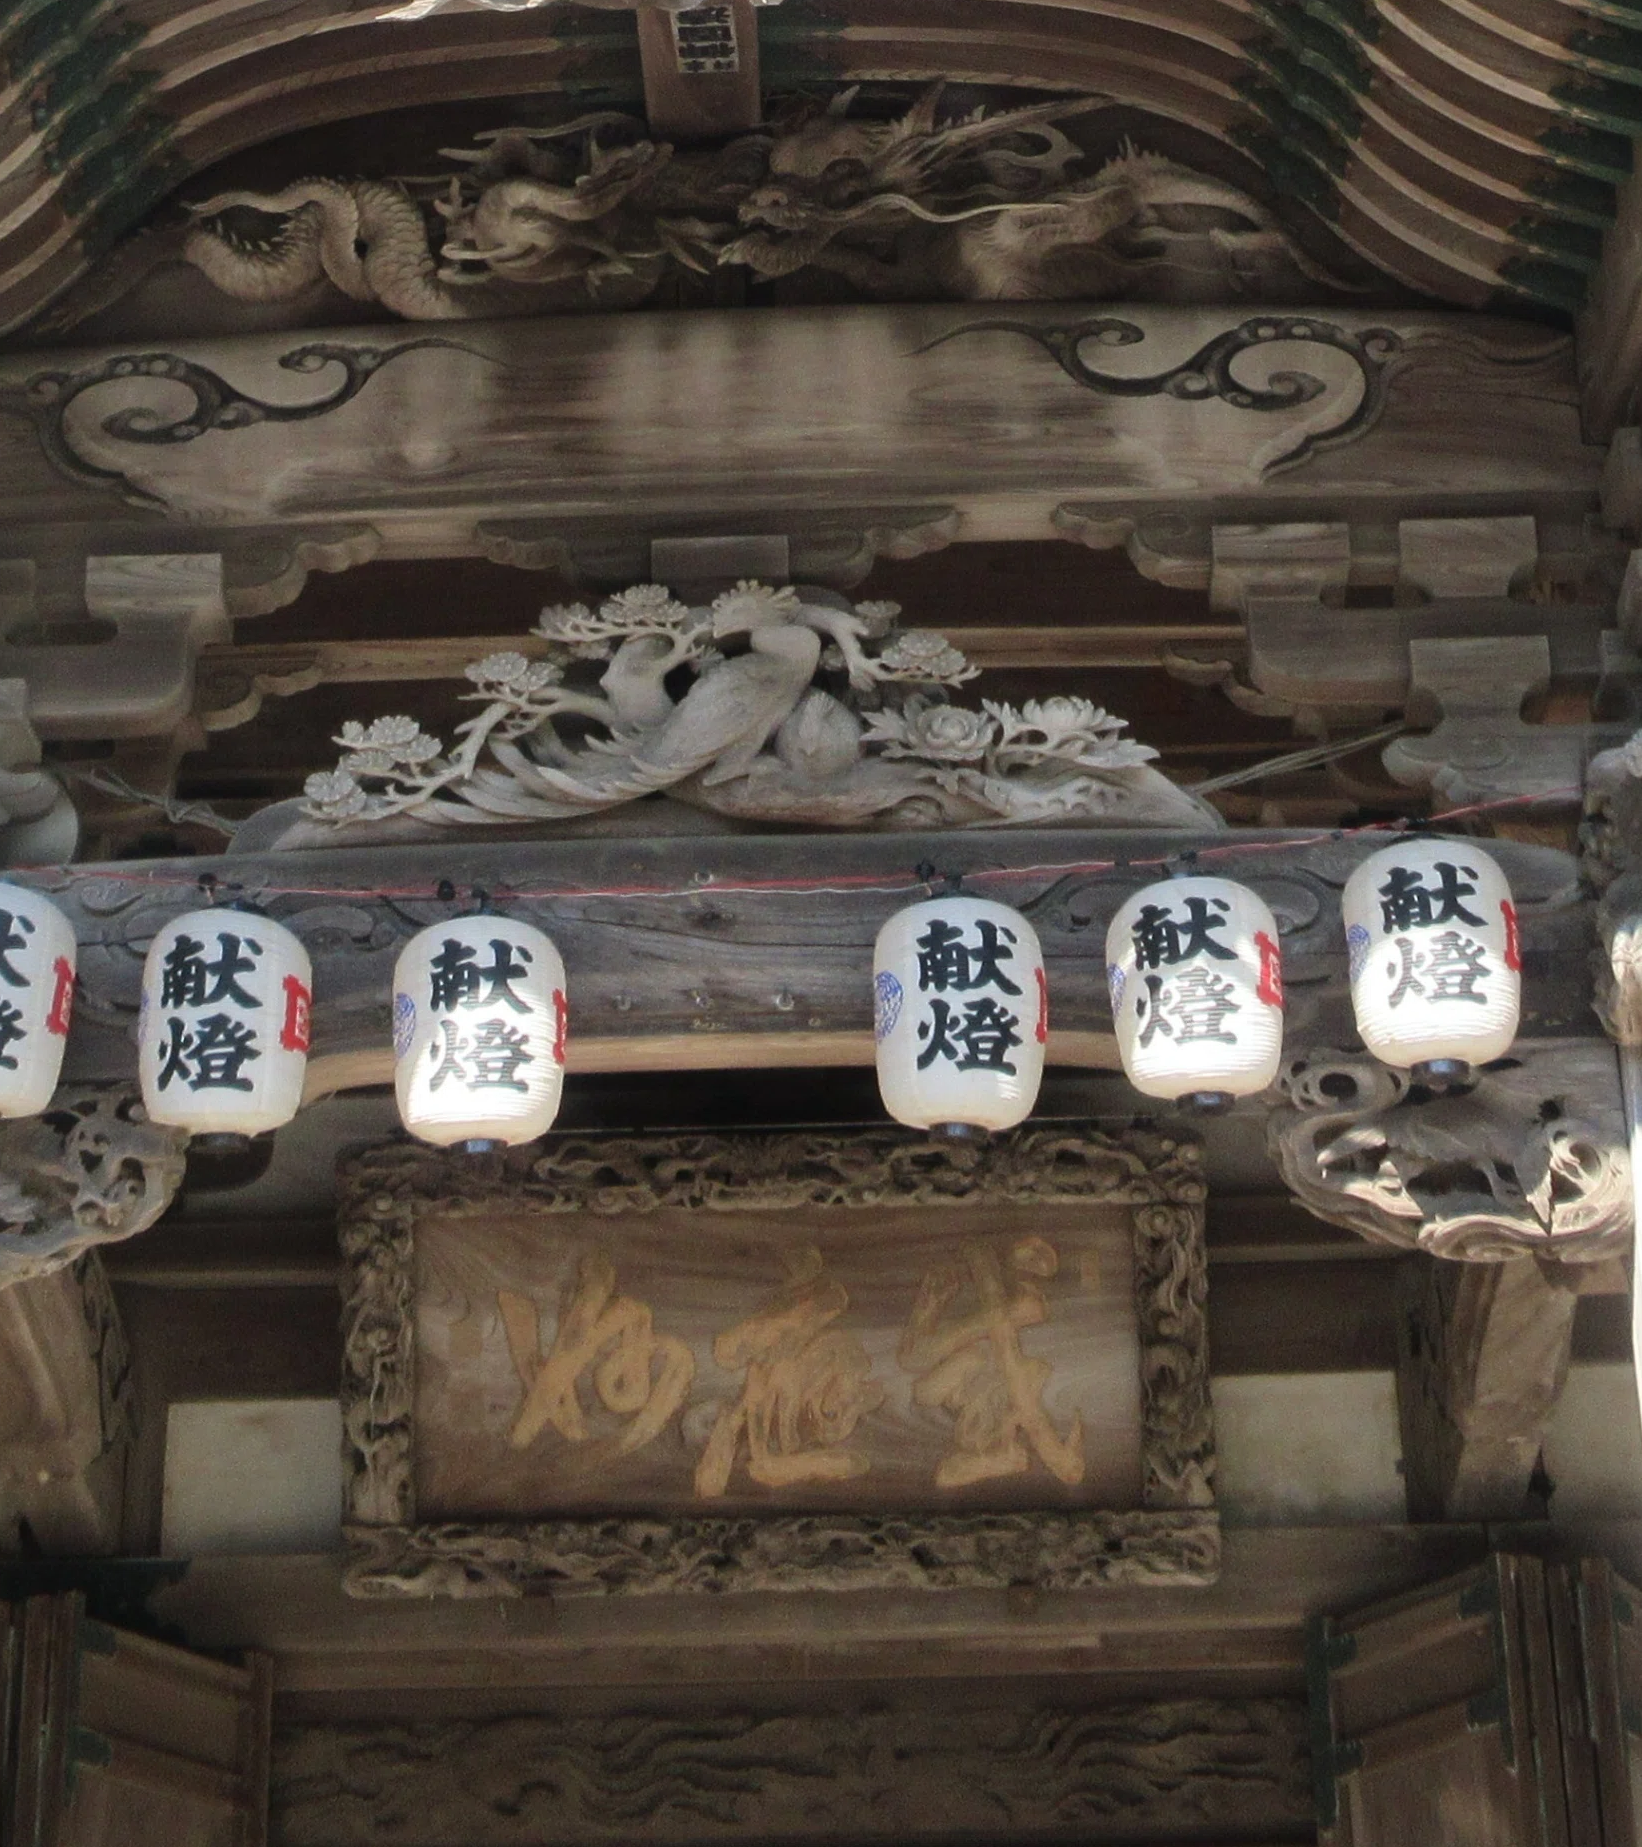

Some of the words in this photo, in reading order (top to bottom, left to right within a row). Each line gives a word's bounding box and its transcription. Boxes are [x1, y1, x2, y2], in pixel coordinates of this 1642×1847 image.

[158, 934, 262, 1091] 献燈
[917, 920, 1022, 1075] 献燈
[1132, 898, 1241, 1044] 献燈
[1380, 863, 1491, 1008] 献燈
[429, 938, 533, 1092] 献燈
